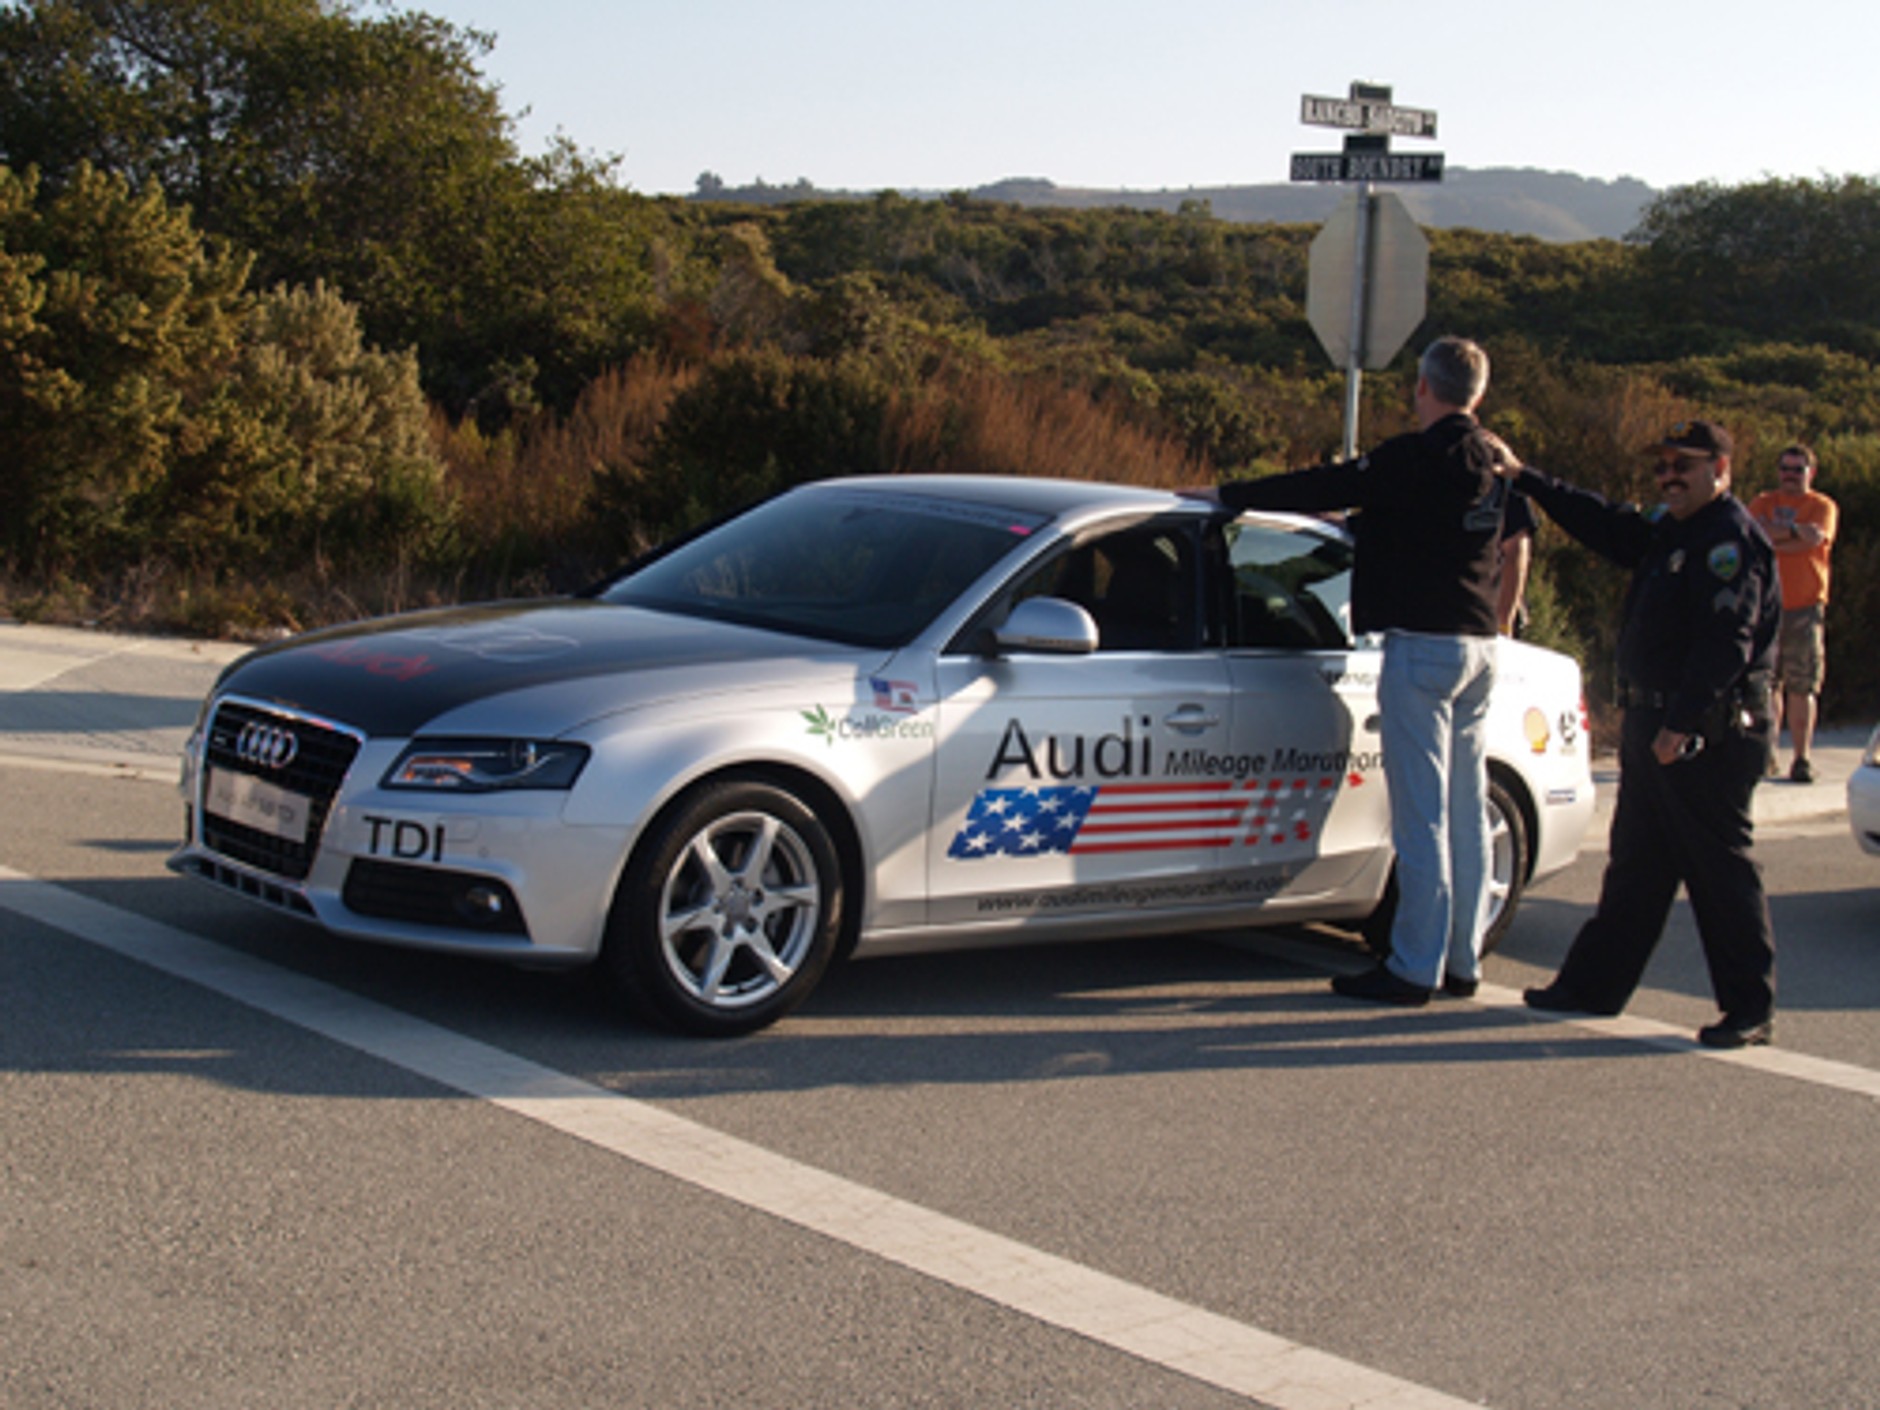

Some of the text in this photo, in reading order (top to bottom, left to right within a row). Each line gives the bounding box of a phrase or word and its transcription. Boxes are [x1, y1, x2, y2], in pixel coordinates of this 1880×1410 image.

[1294, 156, 1341, 180] SOUTH
[985, 716, 1152, 780] Audi
[1163, 748, 1384, 779] Mileage Marathon
[363, 814, 446, 862] TDI
